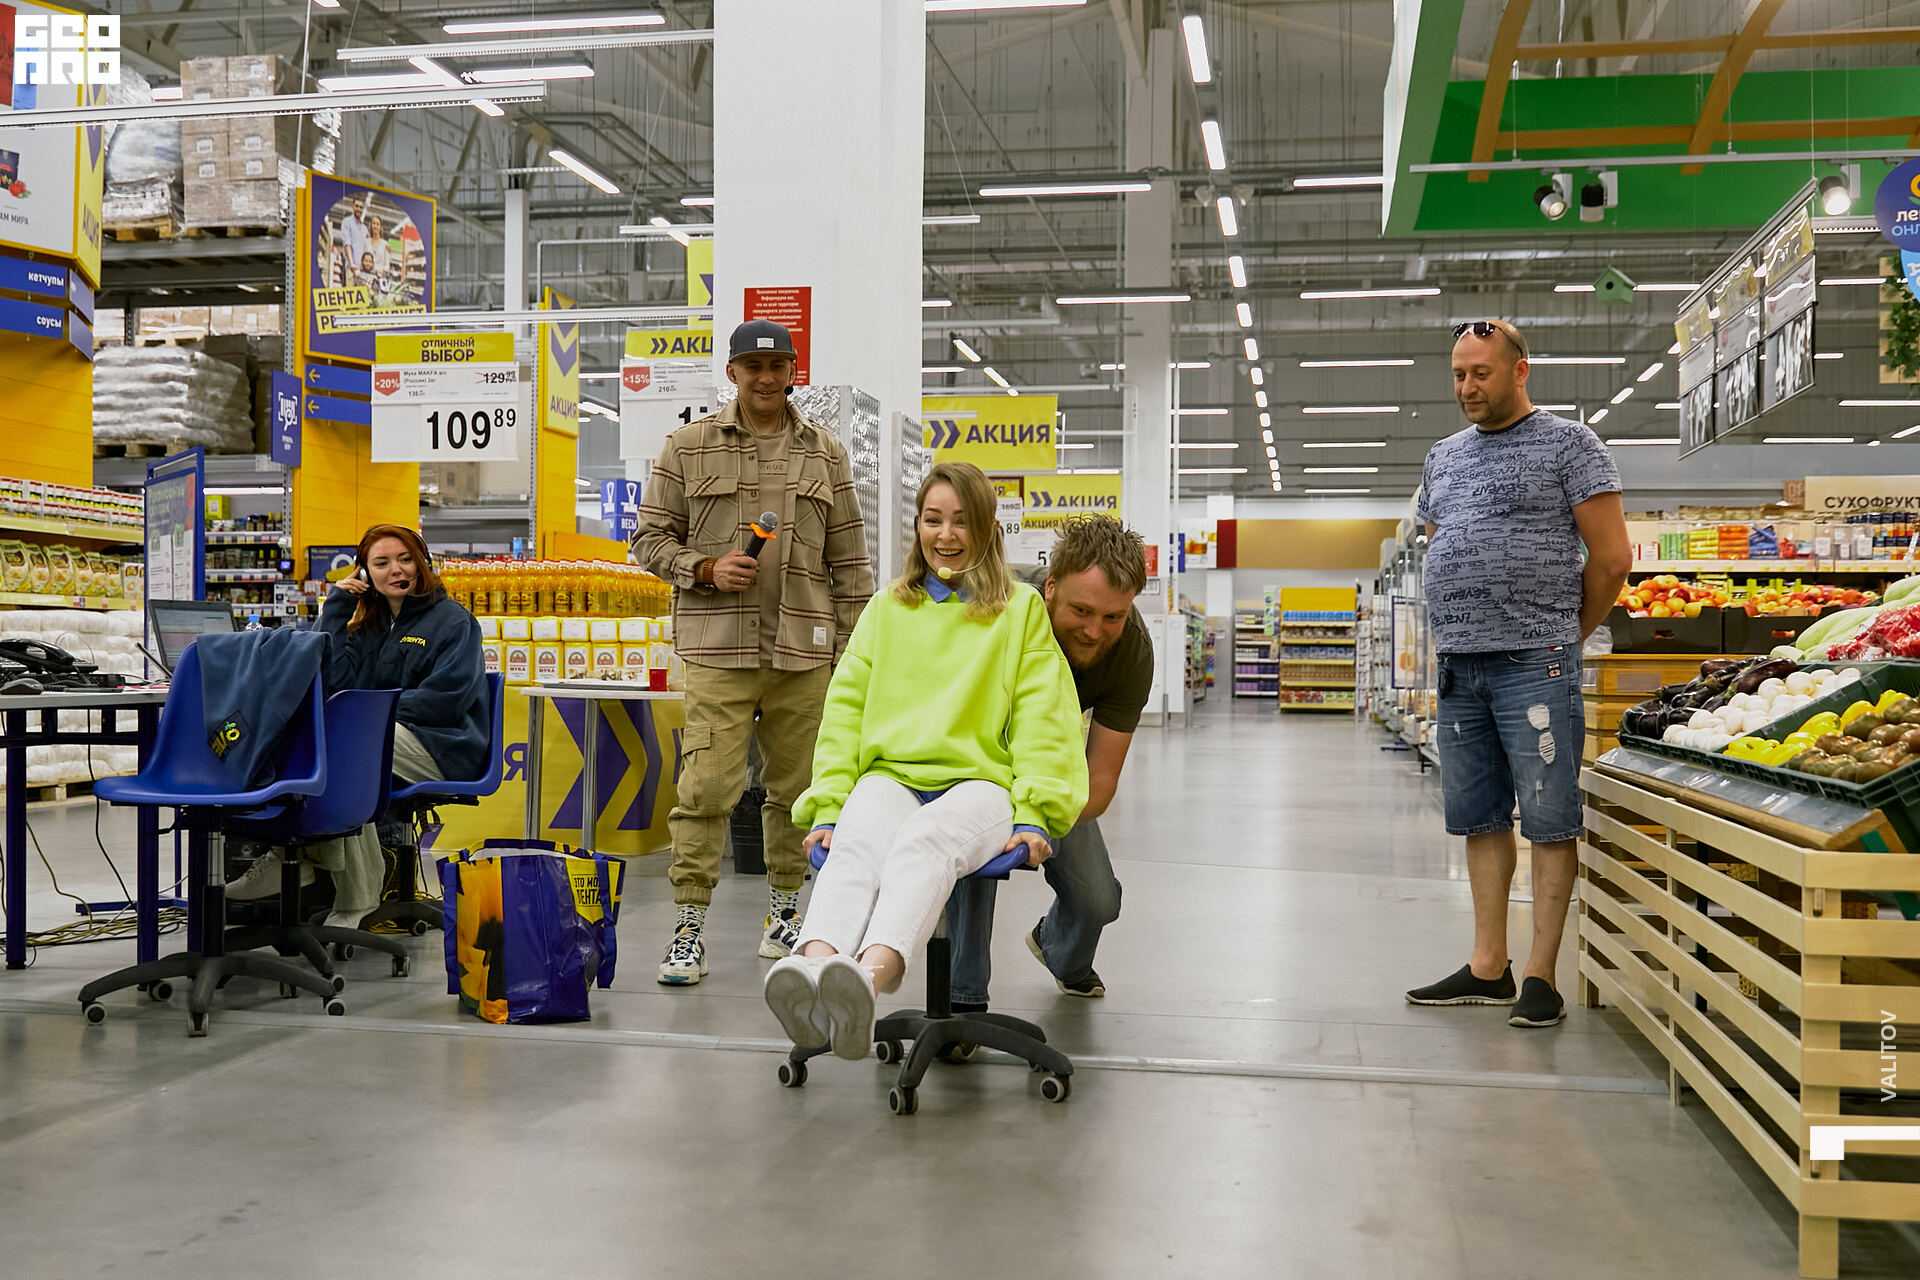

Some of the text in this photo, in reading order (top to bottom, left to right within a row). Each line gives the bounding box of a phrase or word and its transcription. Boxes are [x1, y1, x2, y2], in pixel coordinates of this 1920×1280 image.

[11, 214, 29, 225] МИРА
[1896, 209, 1920, 222] ле
[28, 271, 65, 287] кетчупы
[318, 290, 366, 306] ЛЕНТА
[36, 315, 62, 328] соусы
[421, 337, 475, 349] ОТЛИЧНЫЙ
[670, 336, 713, 356] АКЦ
[421, 349, 474, 362] ВЫБОР
[376, 379, 400, 389] -20%
[624, 374, 650, 384] -15%
[550, 394, 578, 420] АКЦИЯ
[426, 408, 517, 450] 109 89
[965, 424, 1050, 447] АКЦИЯ
[1057, 495, 1117, 509] АКЦИЯ
[621, 518, 638, 529] ВЕСЫ
[1006, 523, 1020, 534] 89
[1024, 519, 1059, 529] АКЦИЯ
[587, 877, 600, 888] МО
